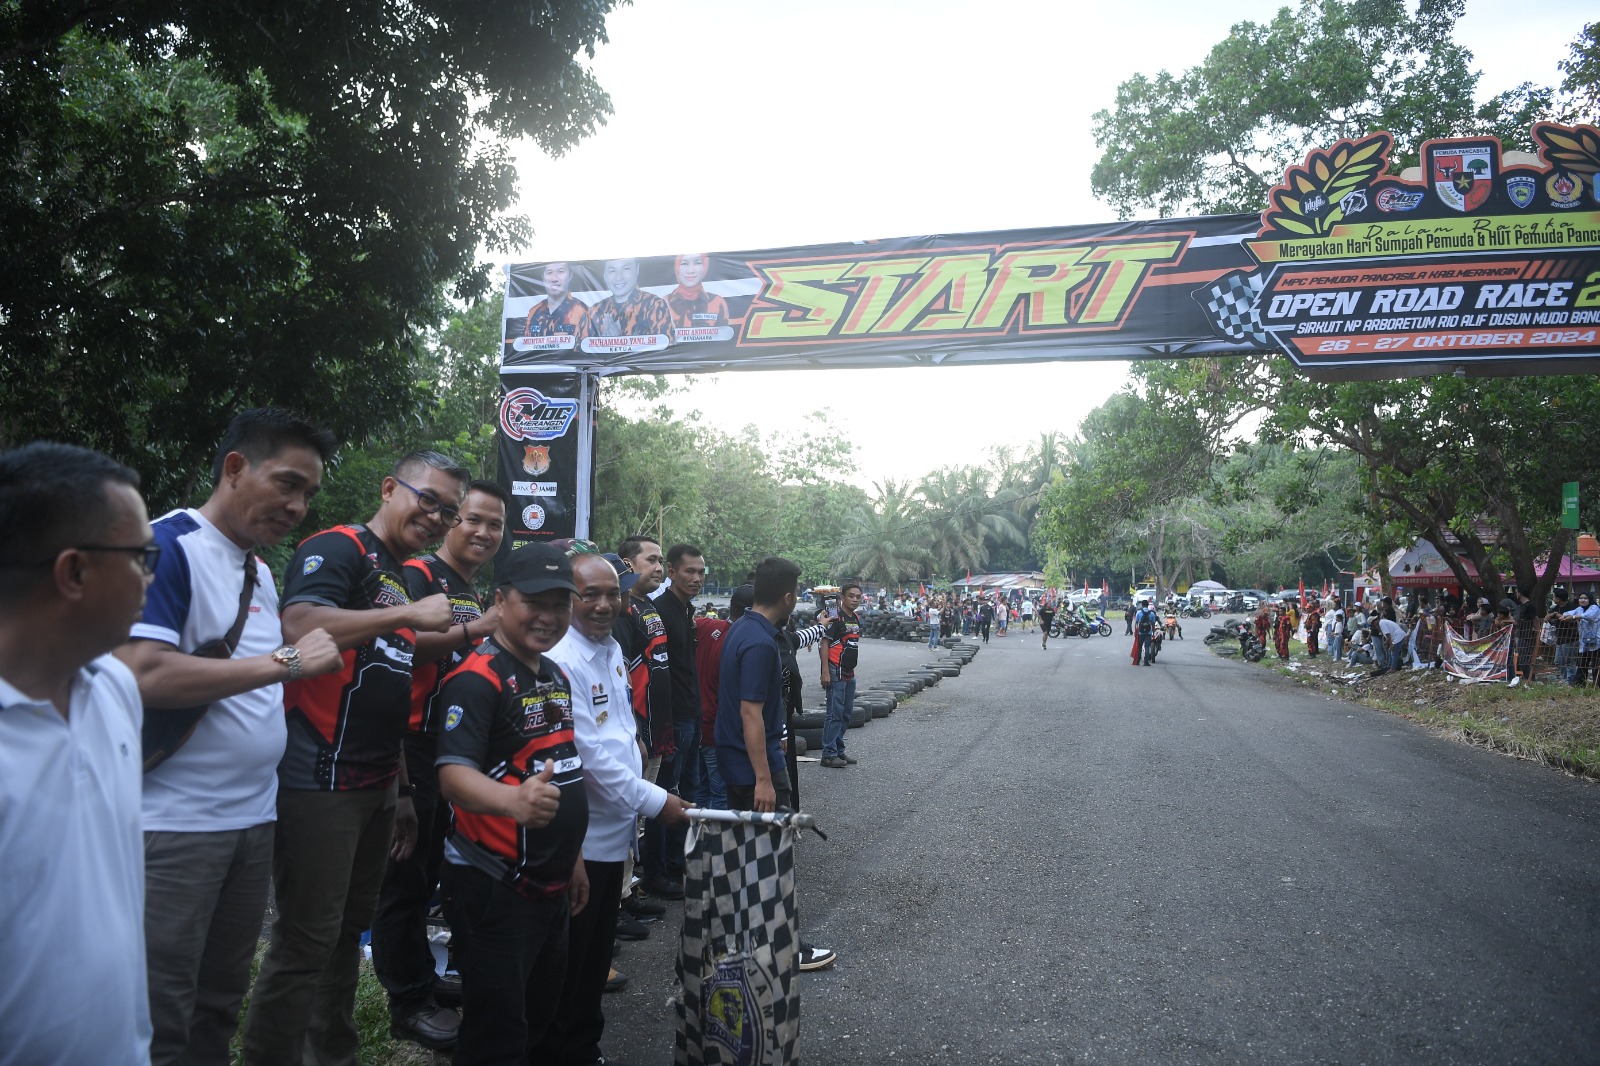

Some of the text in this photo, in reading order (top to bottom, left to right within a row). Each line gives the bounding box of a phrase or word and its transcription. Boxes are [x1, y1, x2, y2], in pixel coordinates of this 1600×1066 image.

[1363, 217, 1574, 239] Dalam Rangka
[1279, 240, 1343, 259] Merayakan
[1347, 238, 1372, 254] Hari
[1375, 233, 1423, 253] Sumpah
[1427, 232, 1474, 249] Pemuda
[1477, 231, 1486, 246] &
[1489, 230, 1511, 246] HUT
[1515, 228, 1563, 246] Pemuda
[1281, 267, 1521, 287] MPC PEMUDA PANCASILA KAB.MERANGIN
[747, 241, 1181, 339] START
[1267, 291, 1362, 319] OPEN
[1369, 286, 1465, 314] ROAD
[1474, 282, 1574, 309] RACE
[1296, 320, 1343, 335] SIRKUIT
[1344, 319, 1362, 333] NP
[1362, 316, 1437, 332] ARBORETUM
[1437, 315, 1459, 328] RIO
[1460, 314, 1488, 327] ALIF
[1488, 313, 1533, 326] DUSUN
[1533, 311, 1569, 325] MUDO
[589, 338, 628, 347] MUHAMMAD
[1318, 339, 1351, 352] 26
[1373, 336, 1410, 350] 27
[1412, 332, 1525, 348] OKTOBER
[1529, 330, 1597, 345] 2024
[747, 968, 775, 1056] JAMBI
